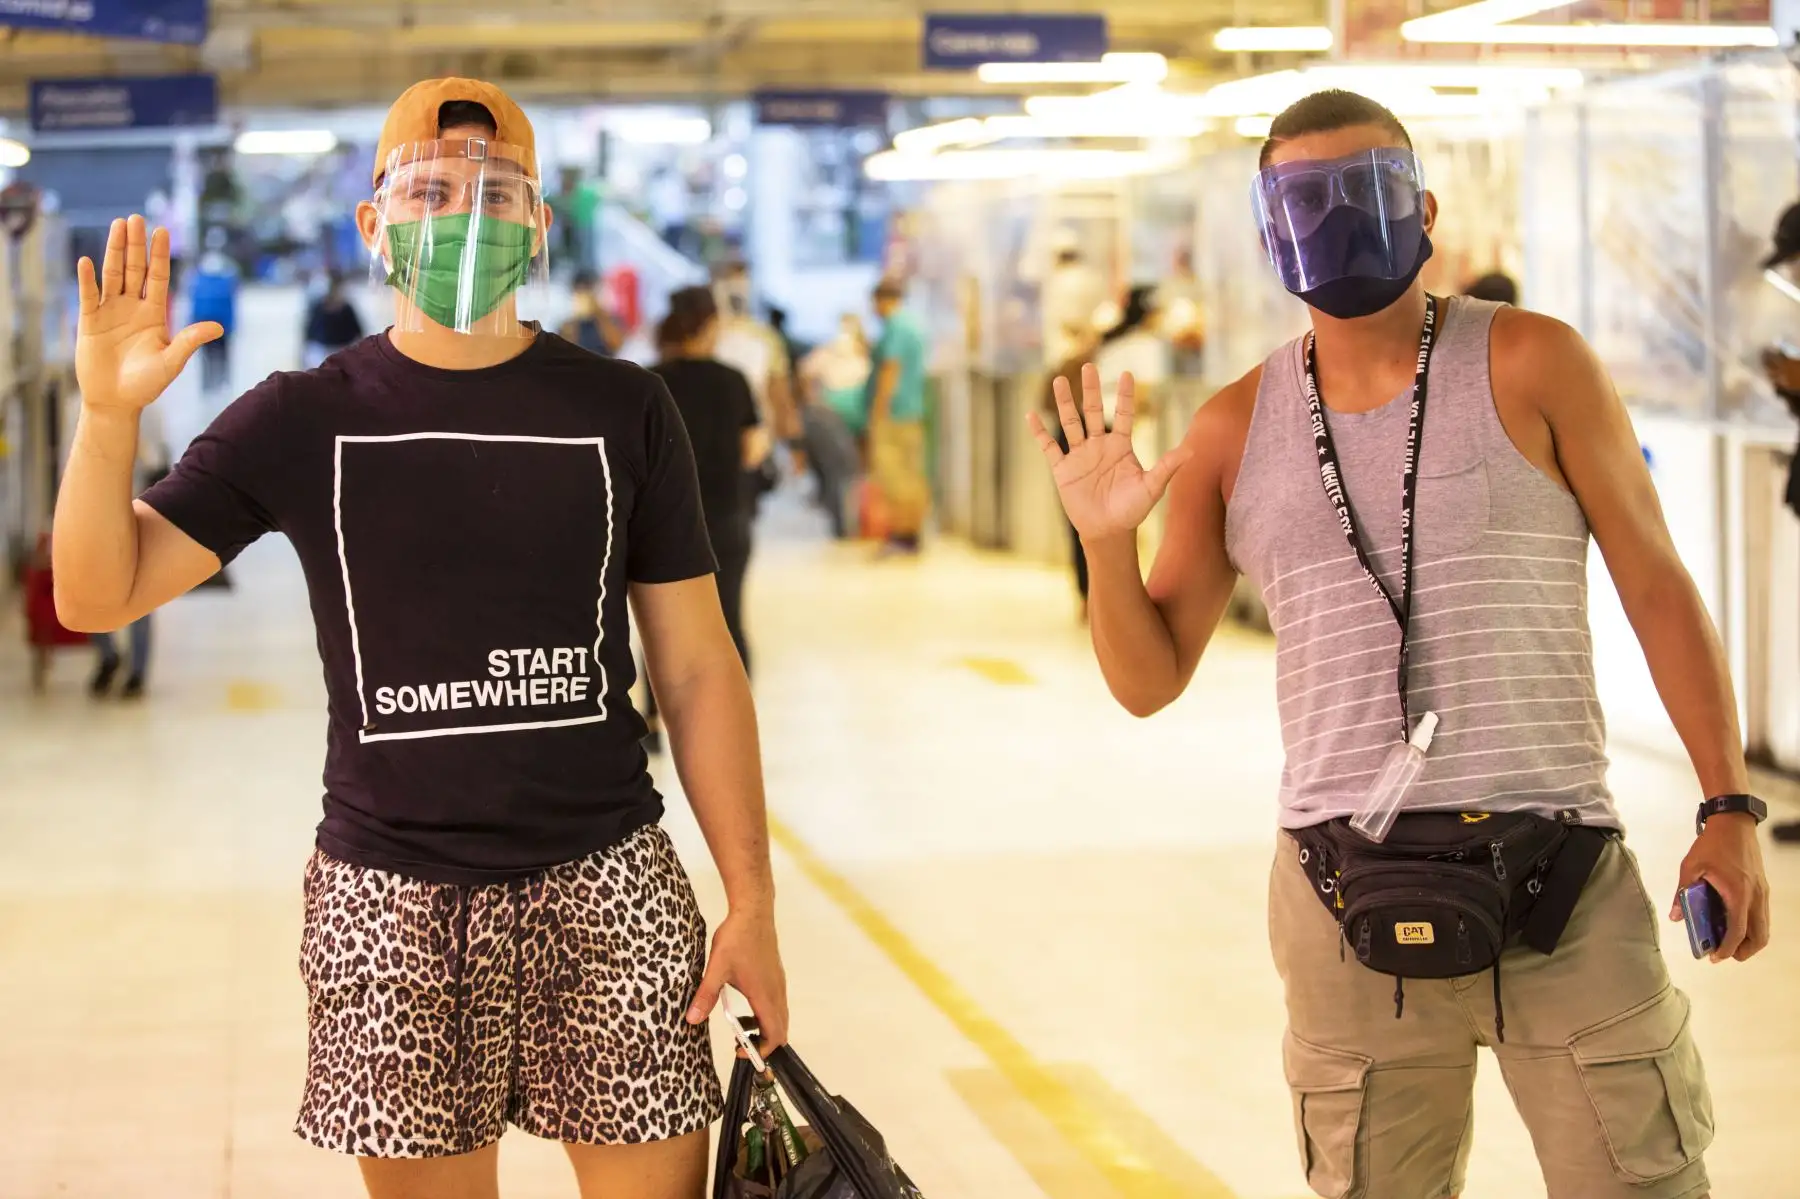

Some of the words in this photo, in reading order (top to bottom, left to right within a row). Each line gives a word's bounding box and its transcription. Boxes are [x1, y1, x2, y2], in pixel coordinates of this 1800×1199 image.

[1320, 461, 1345, 507] WHITE
[1337, 506, 1353, 536] FOX
[487, 647, 588, 677] START
[375, 676, 590, 715] SOMEWHERE
[1403, 926, 1424, 936] CAT
